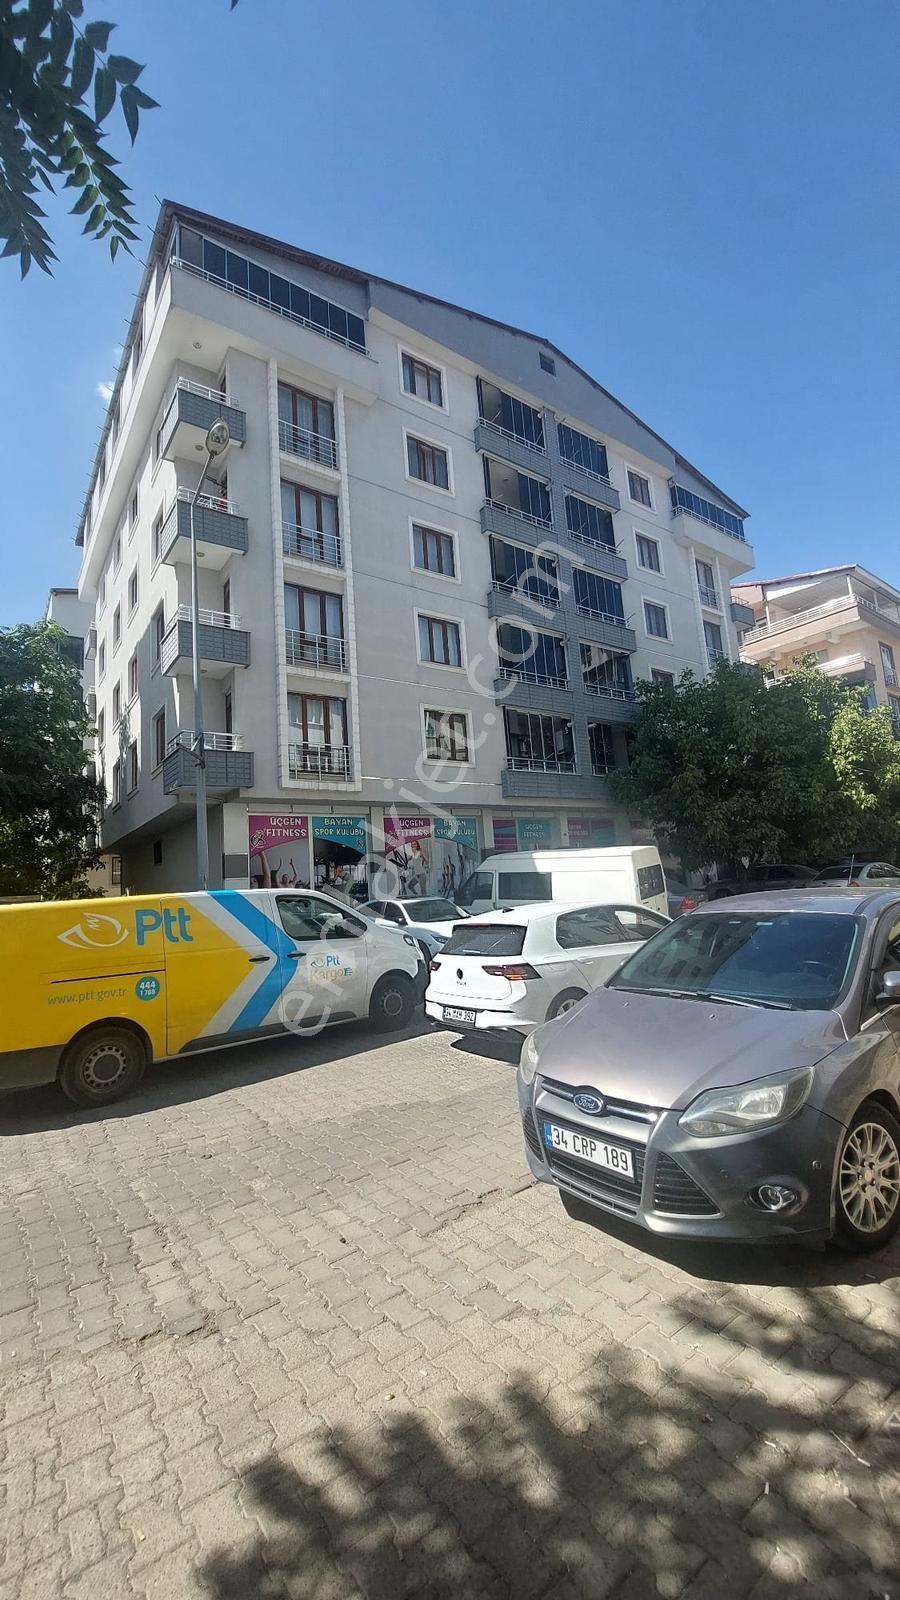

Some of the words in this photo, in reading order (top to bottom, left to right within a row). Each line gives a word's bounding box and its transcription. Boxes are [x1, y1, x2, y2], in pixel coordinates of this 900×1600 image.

[324, 817, 353, 826] BAYAN
[266, 828, 307, 837] FITNESS
[314, 828, 334, 836] SPOR
[135, 907, 194, 946] Ptt
[326, 954, 341, 967] Ptt
[139, 980, 156, 990] 444
[47, 987, 128, 1005] www.ptt.gov.tr
[578, 1097, 596, 1110] Ford
[552, 1127, 568, 1149] 34
[572, 1134, 597, 1158] CRP
[603, 1145, 629, 1172] 189
